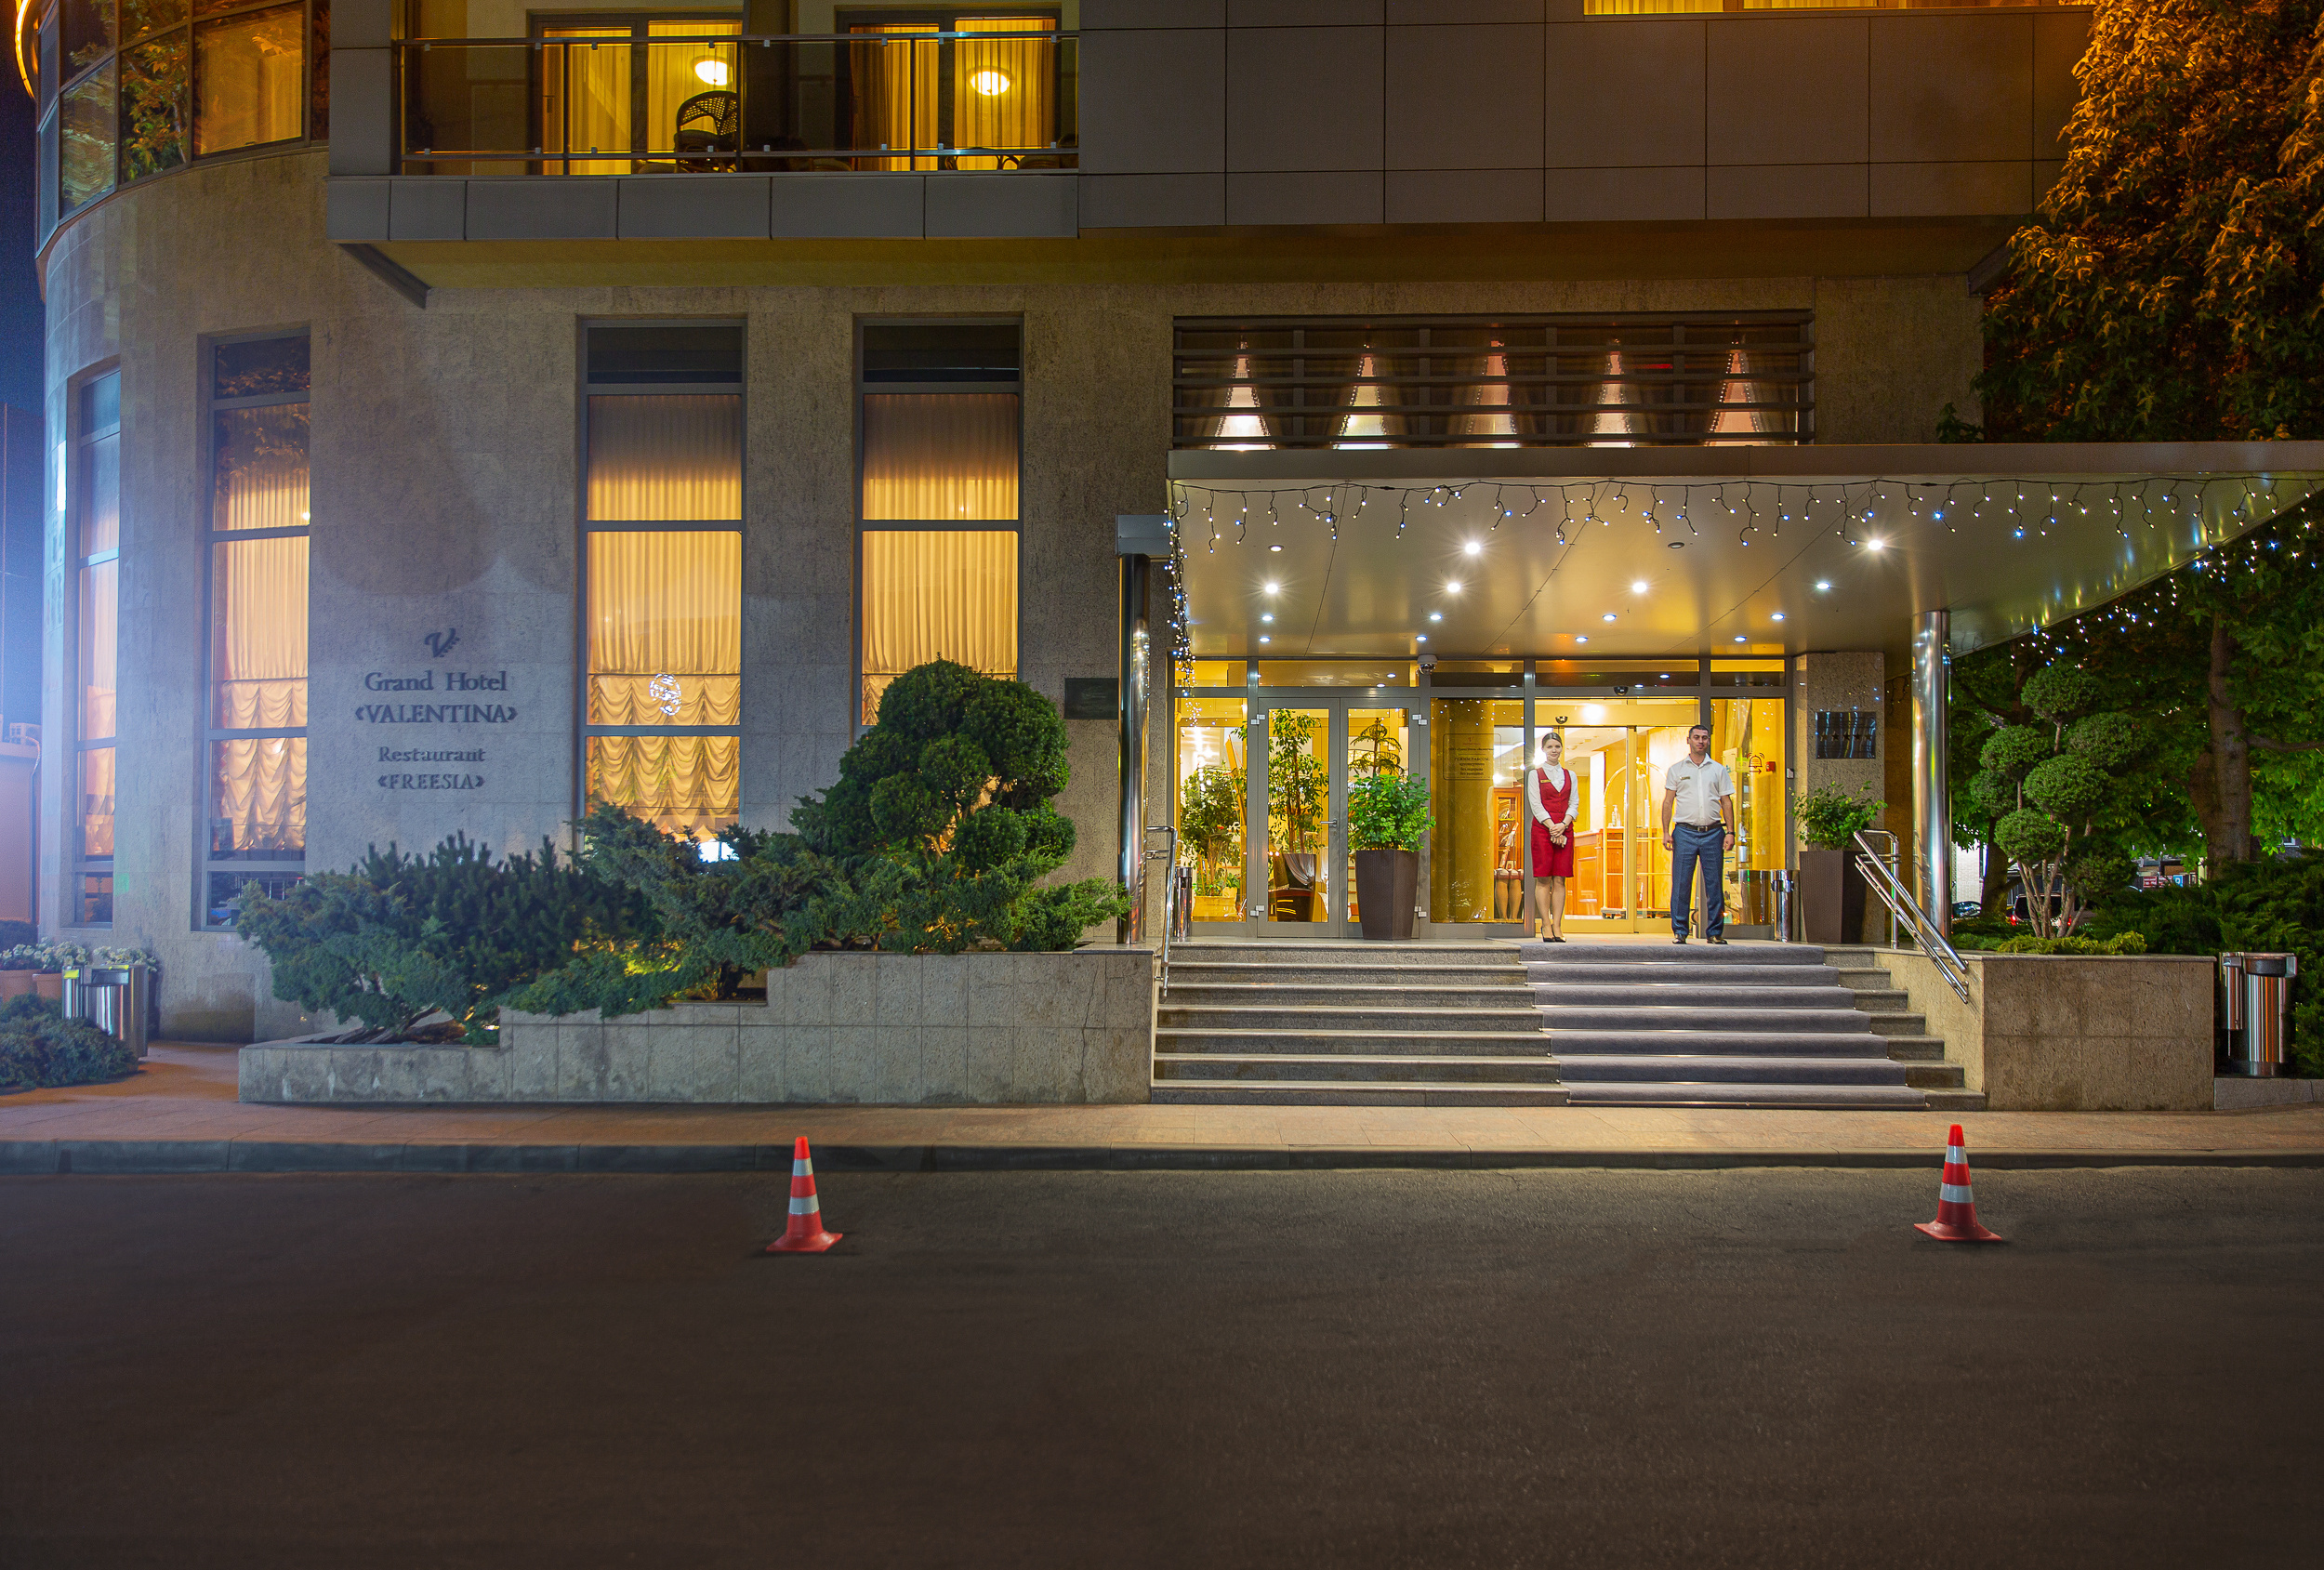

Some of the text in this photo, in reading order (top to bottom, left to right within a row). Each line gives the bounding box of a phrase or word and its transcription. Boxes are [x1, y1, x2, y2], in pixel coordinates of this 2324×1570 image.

[364, 670, 508, 691] Grand Hotel
[377, 746, 486, 762] Restaurant
